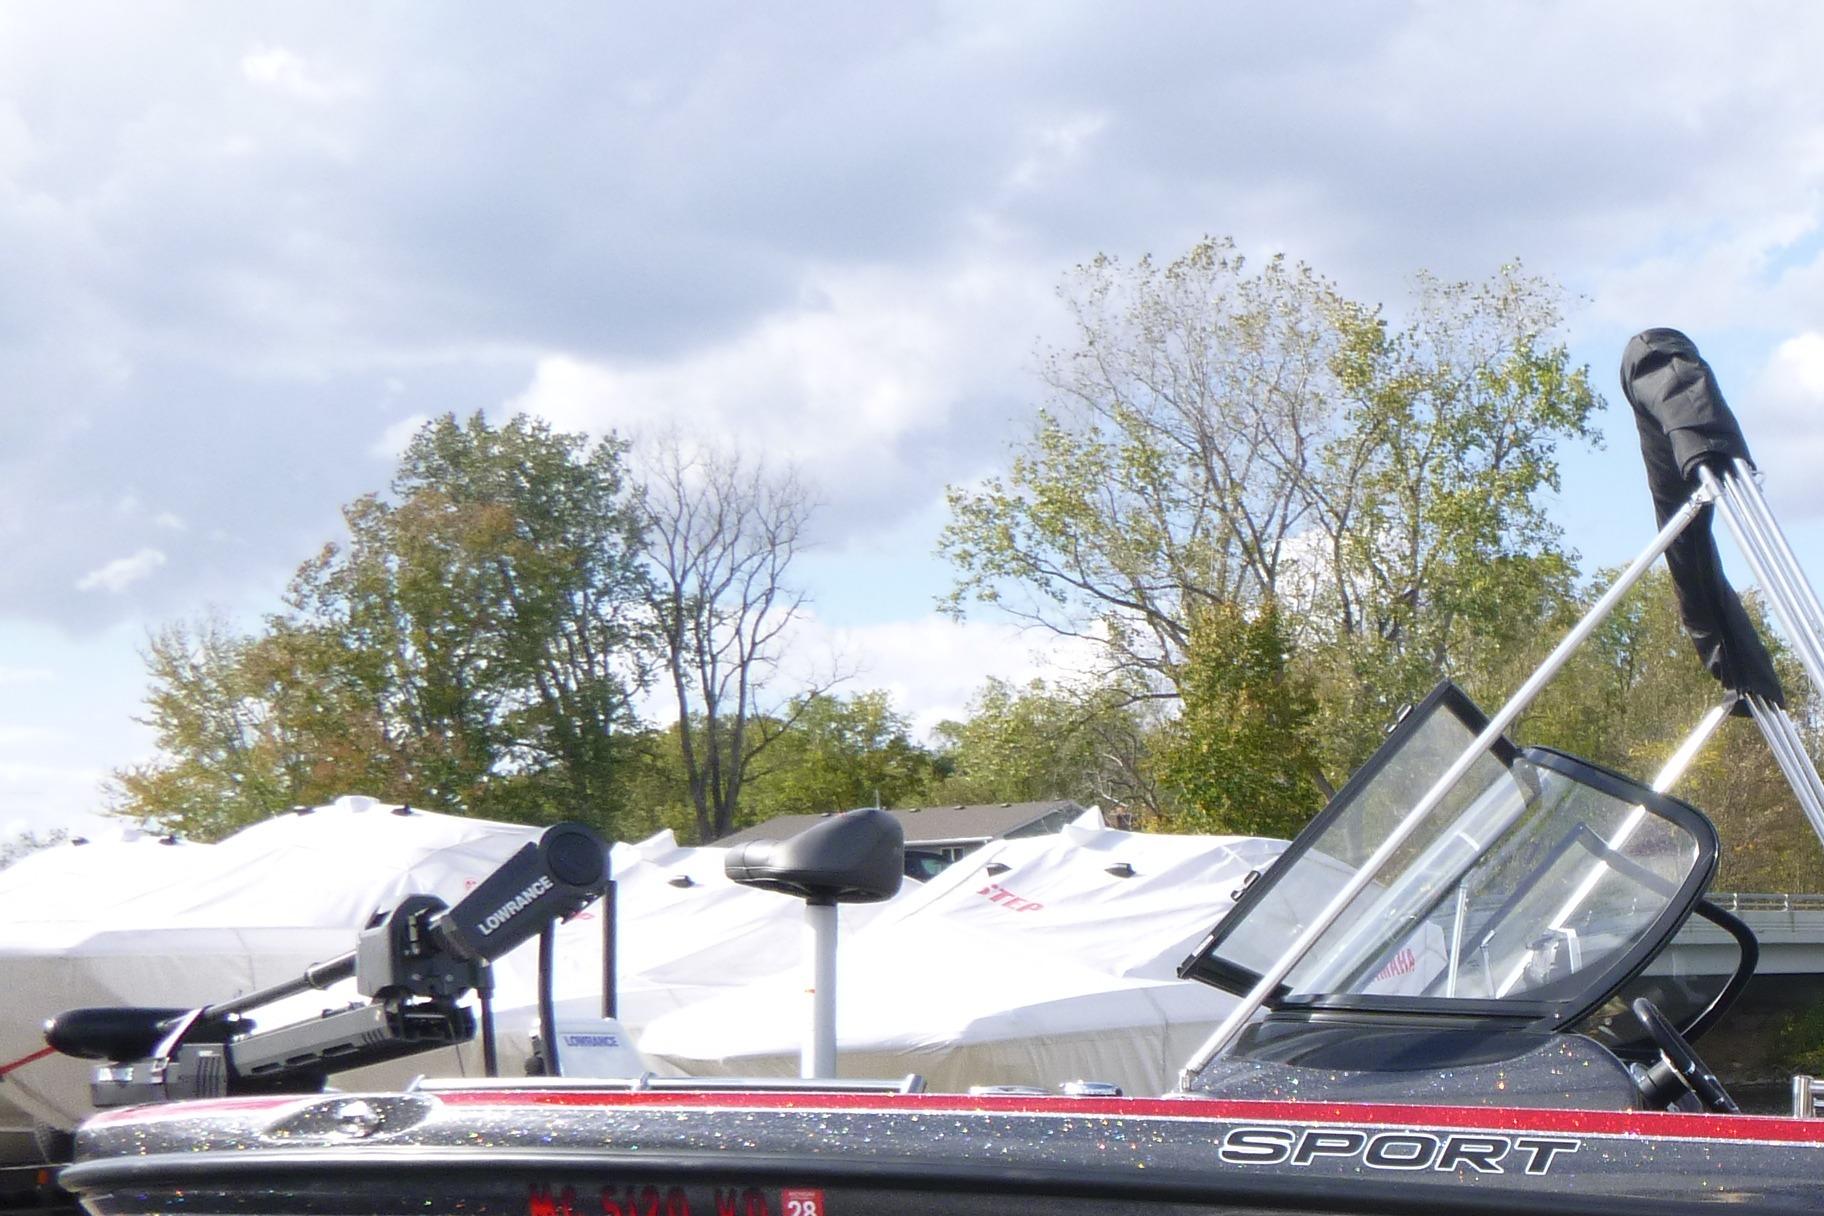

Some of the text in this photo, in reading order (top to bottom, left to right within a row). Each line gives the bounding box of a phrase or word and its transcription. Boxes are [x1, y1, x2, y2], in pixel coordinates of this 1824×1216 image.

[477, 875, 555, 936] LOWRANCE
[564, 1035, 619, 1048] LOWRANCE
[1219, 1126, 1582, 1176] SPORT
